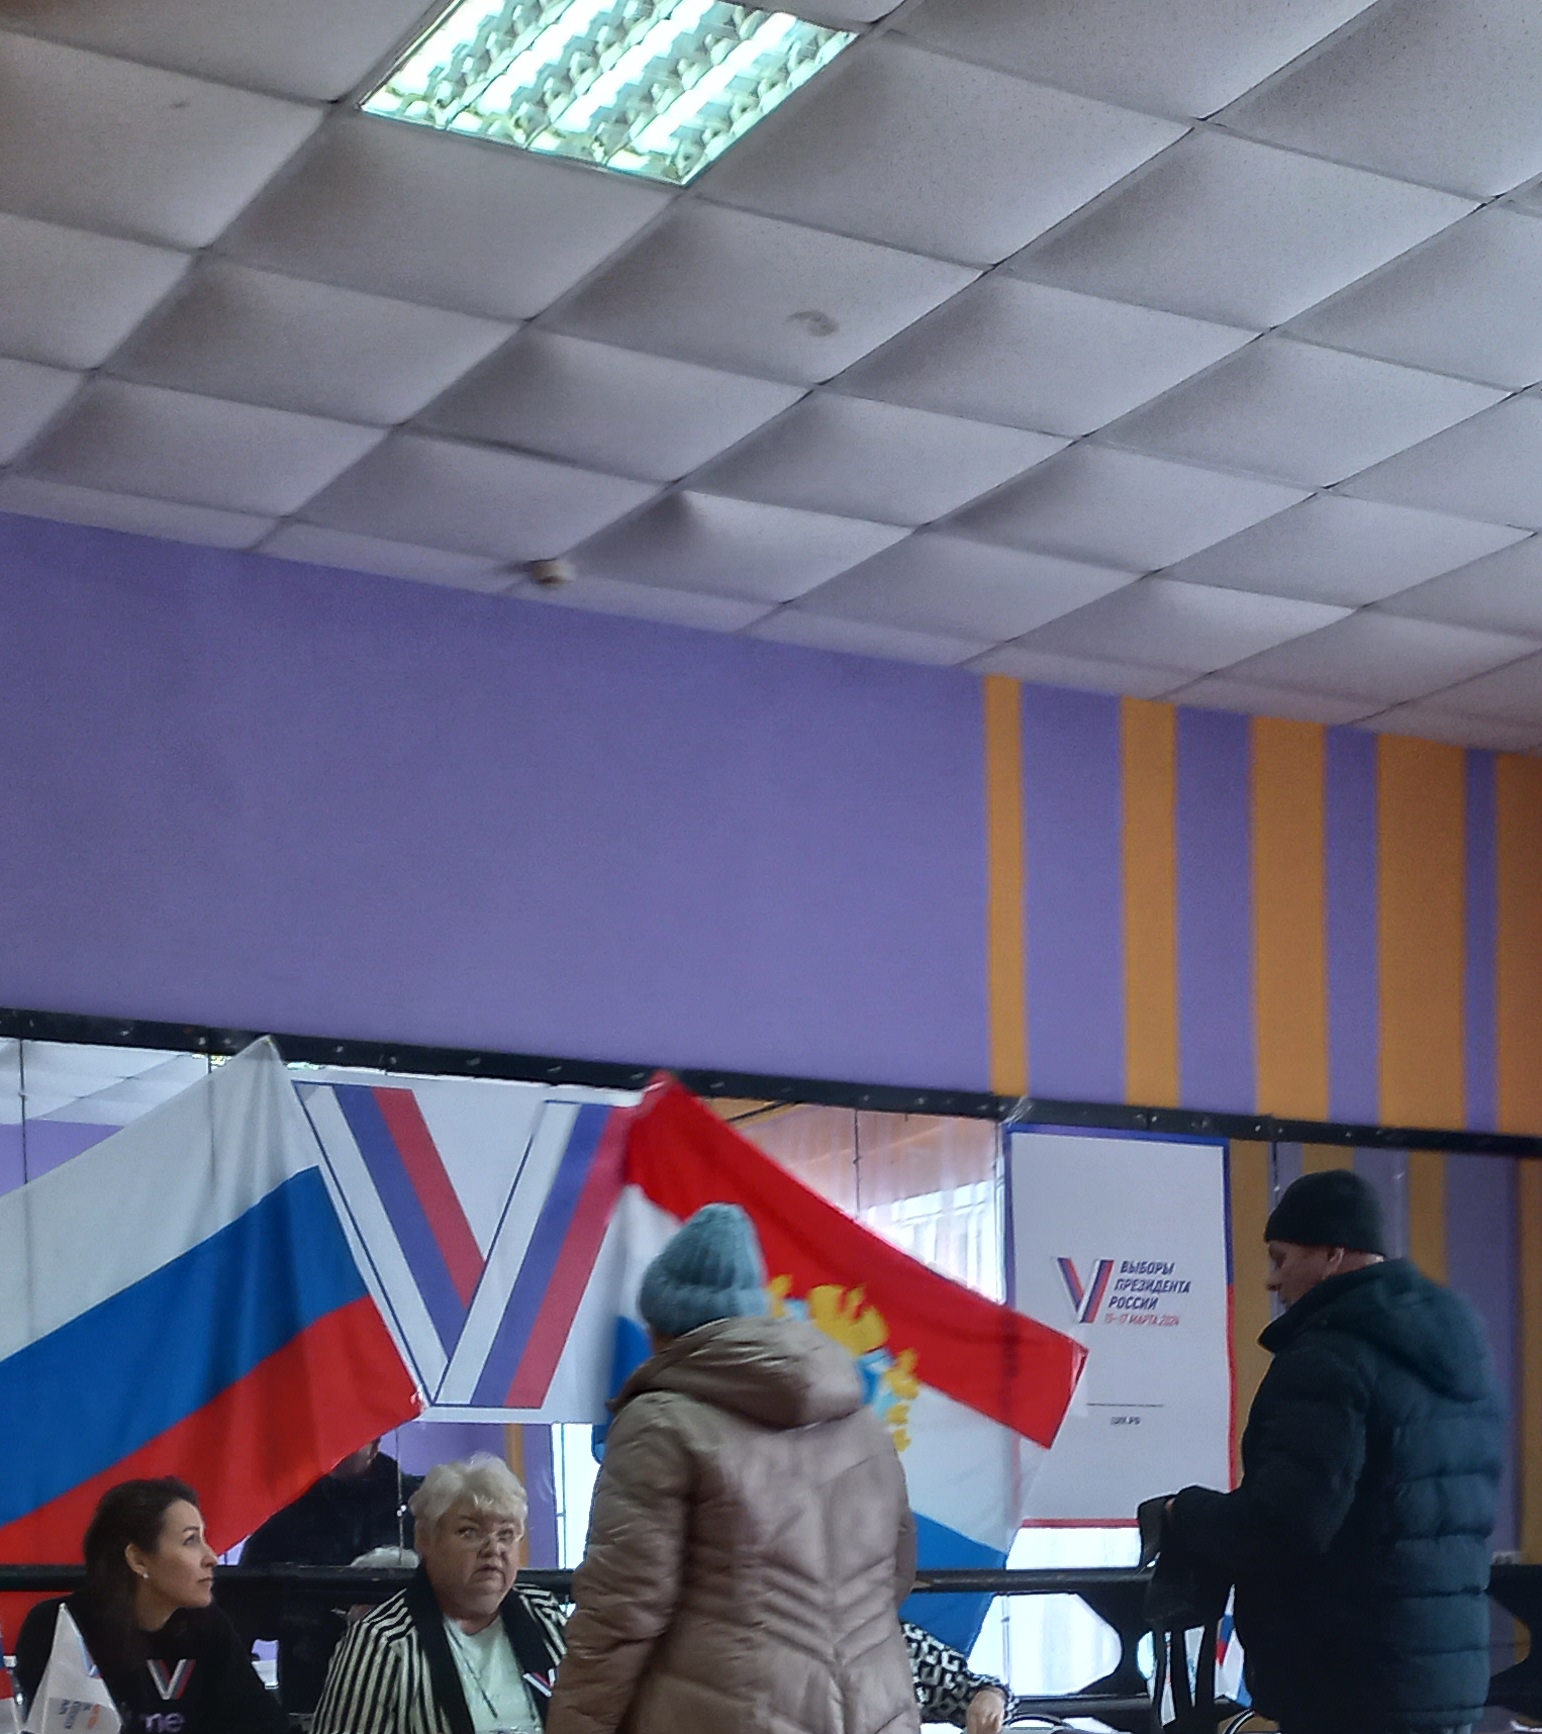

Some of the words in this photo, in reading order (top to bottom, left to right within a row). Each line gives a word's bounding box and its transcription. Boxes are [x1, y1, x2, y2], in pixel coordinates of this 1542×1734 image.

[1119, 1260, 1175, 1275] ВЫБОРЫ
[1114, 1278, 1192, 1295] ПРЕЗИДЕНТА
[1108, 1296, 1159, 1311] РОССИИ
